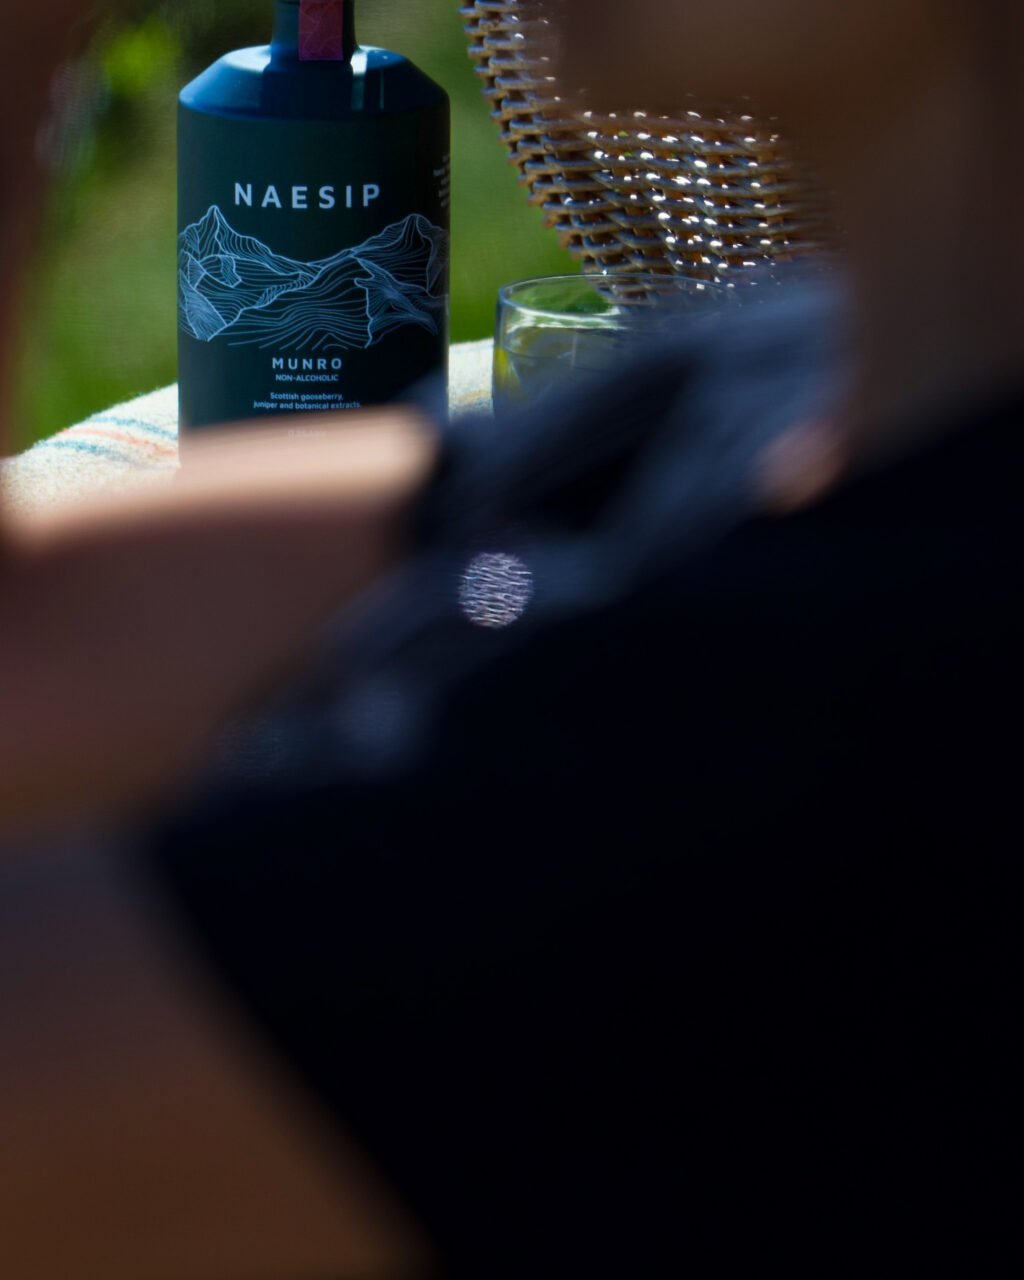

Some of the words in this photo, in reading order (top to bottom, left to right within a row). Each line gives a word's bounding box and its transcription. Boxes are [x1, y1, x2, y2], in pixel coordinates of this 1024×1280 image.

[234, 182, 381, 209] NAESIP
[271, 357, 343, 370] MUNRO
[275, 374, 339, 382] NON-ALCOHOLIC
[270, 392, 299, 400] Scottish
[295, 402, 329, 410] botanical
